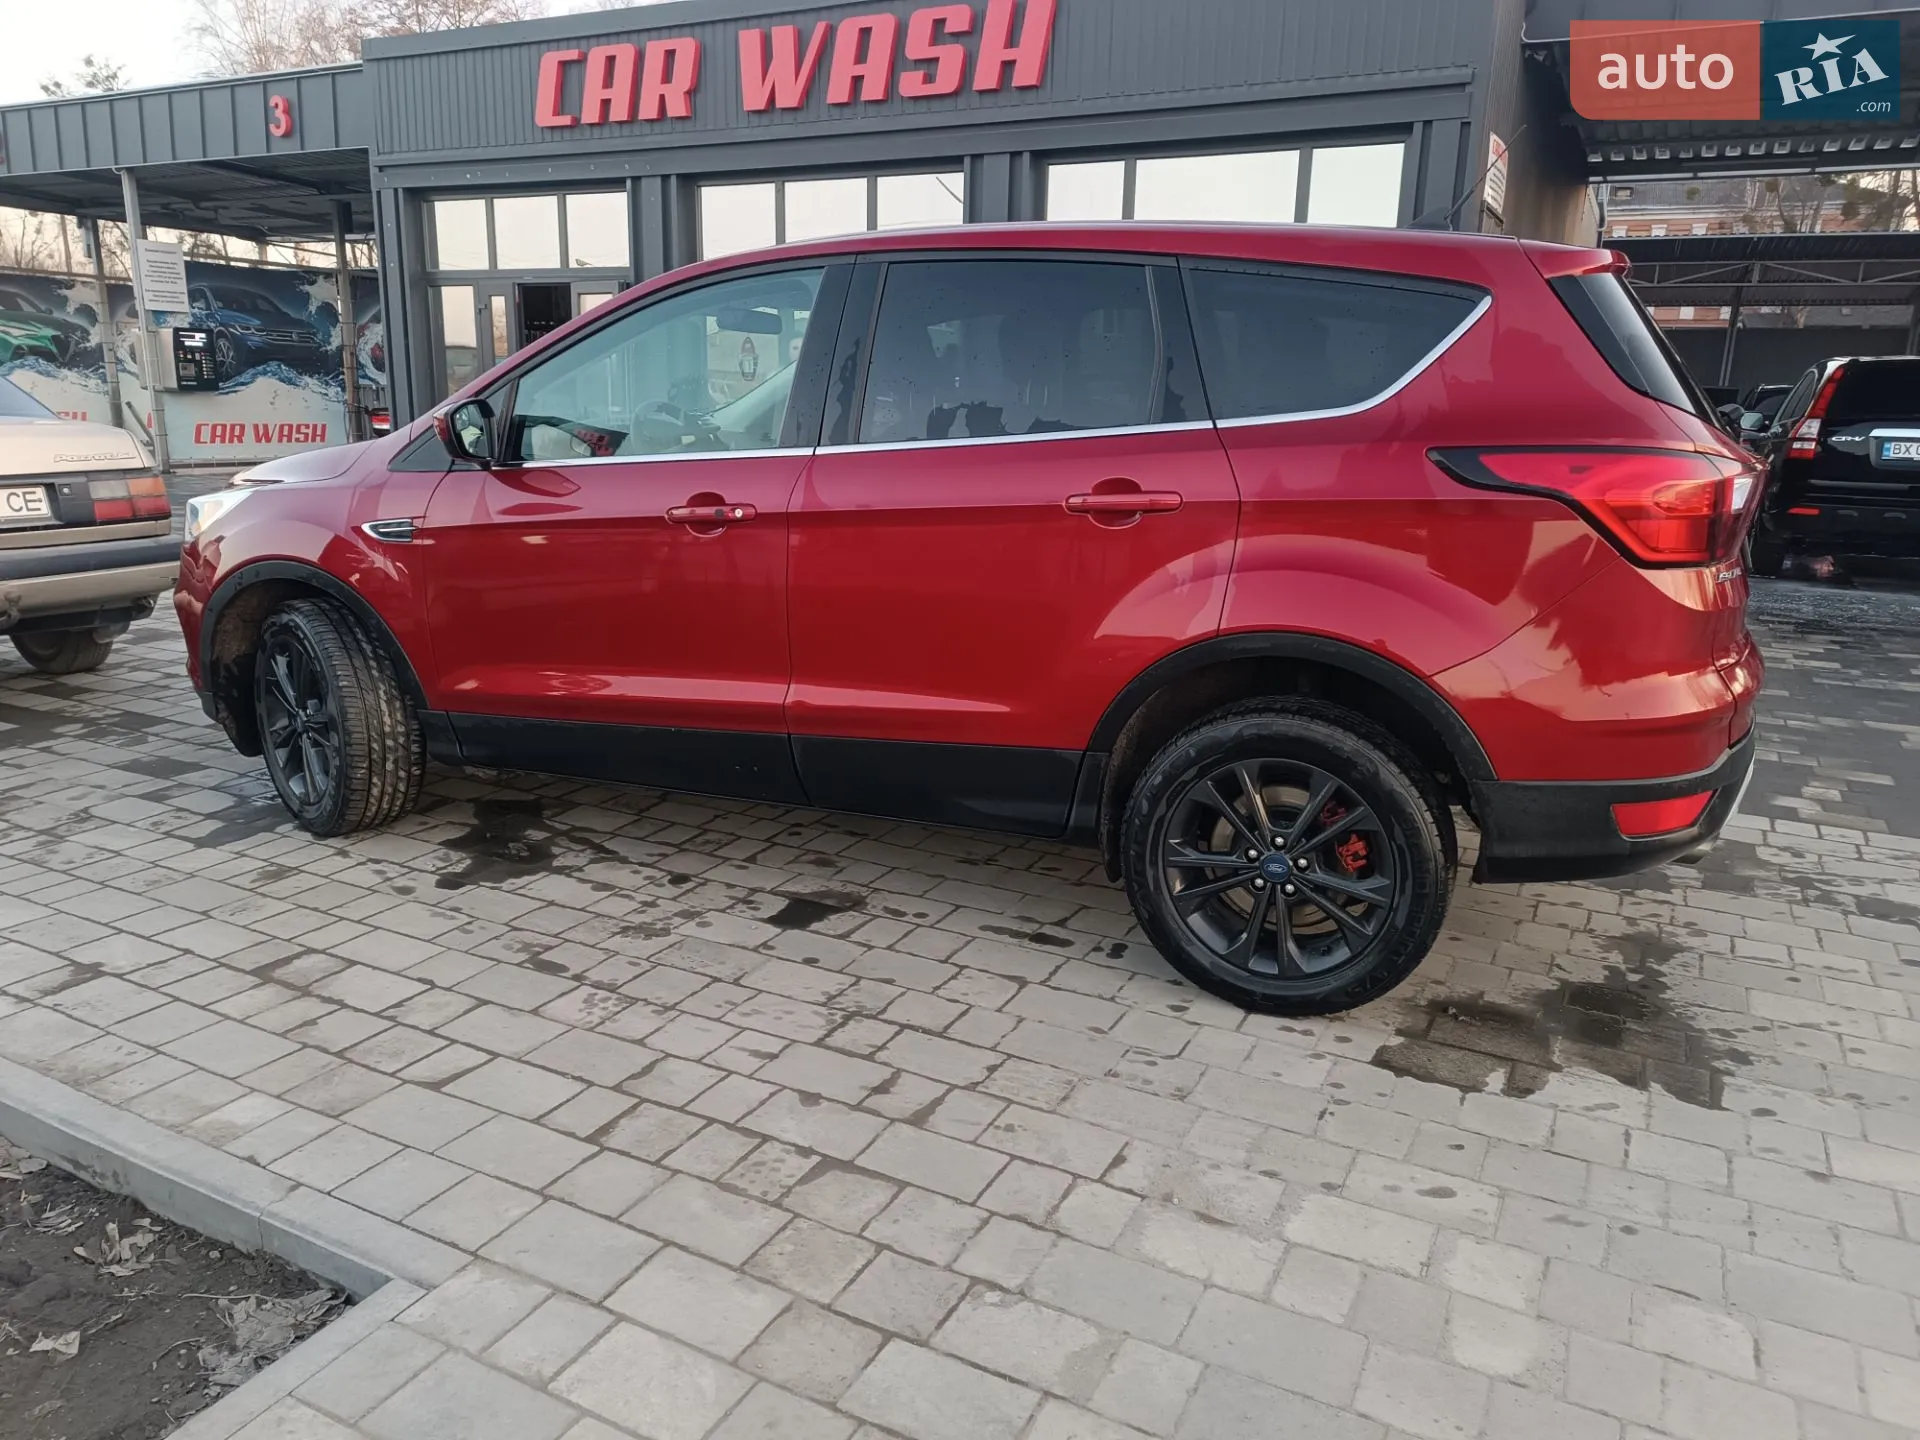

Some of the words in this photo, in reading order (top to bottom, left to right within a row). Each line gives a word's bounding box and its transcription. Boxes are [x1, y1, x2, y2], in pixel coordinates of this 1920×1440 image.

[534, 37, 699, 128] CAR
[738, 0, 1057, 112] WASH
[269, 95, 292, 137] 3
[194, 422, 246, 444] CAR
[252, 422, 327, 444] WASH
[6, 491, 42, 513] CE
